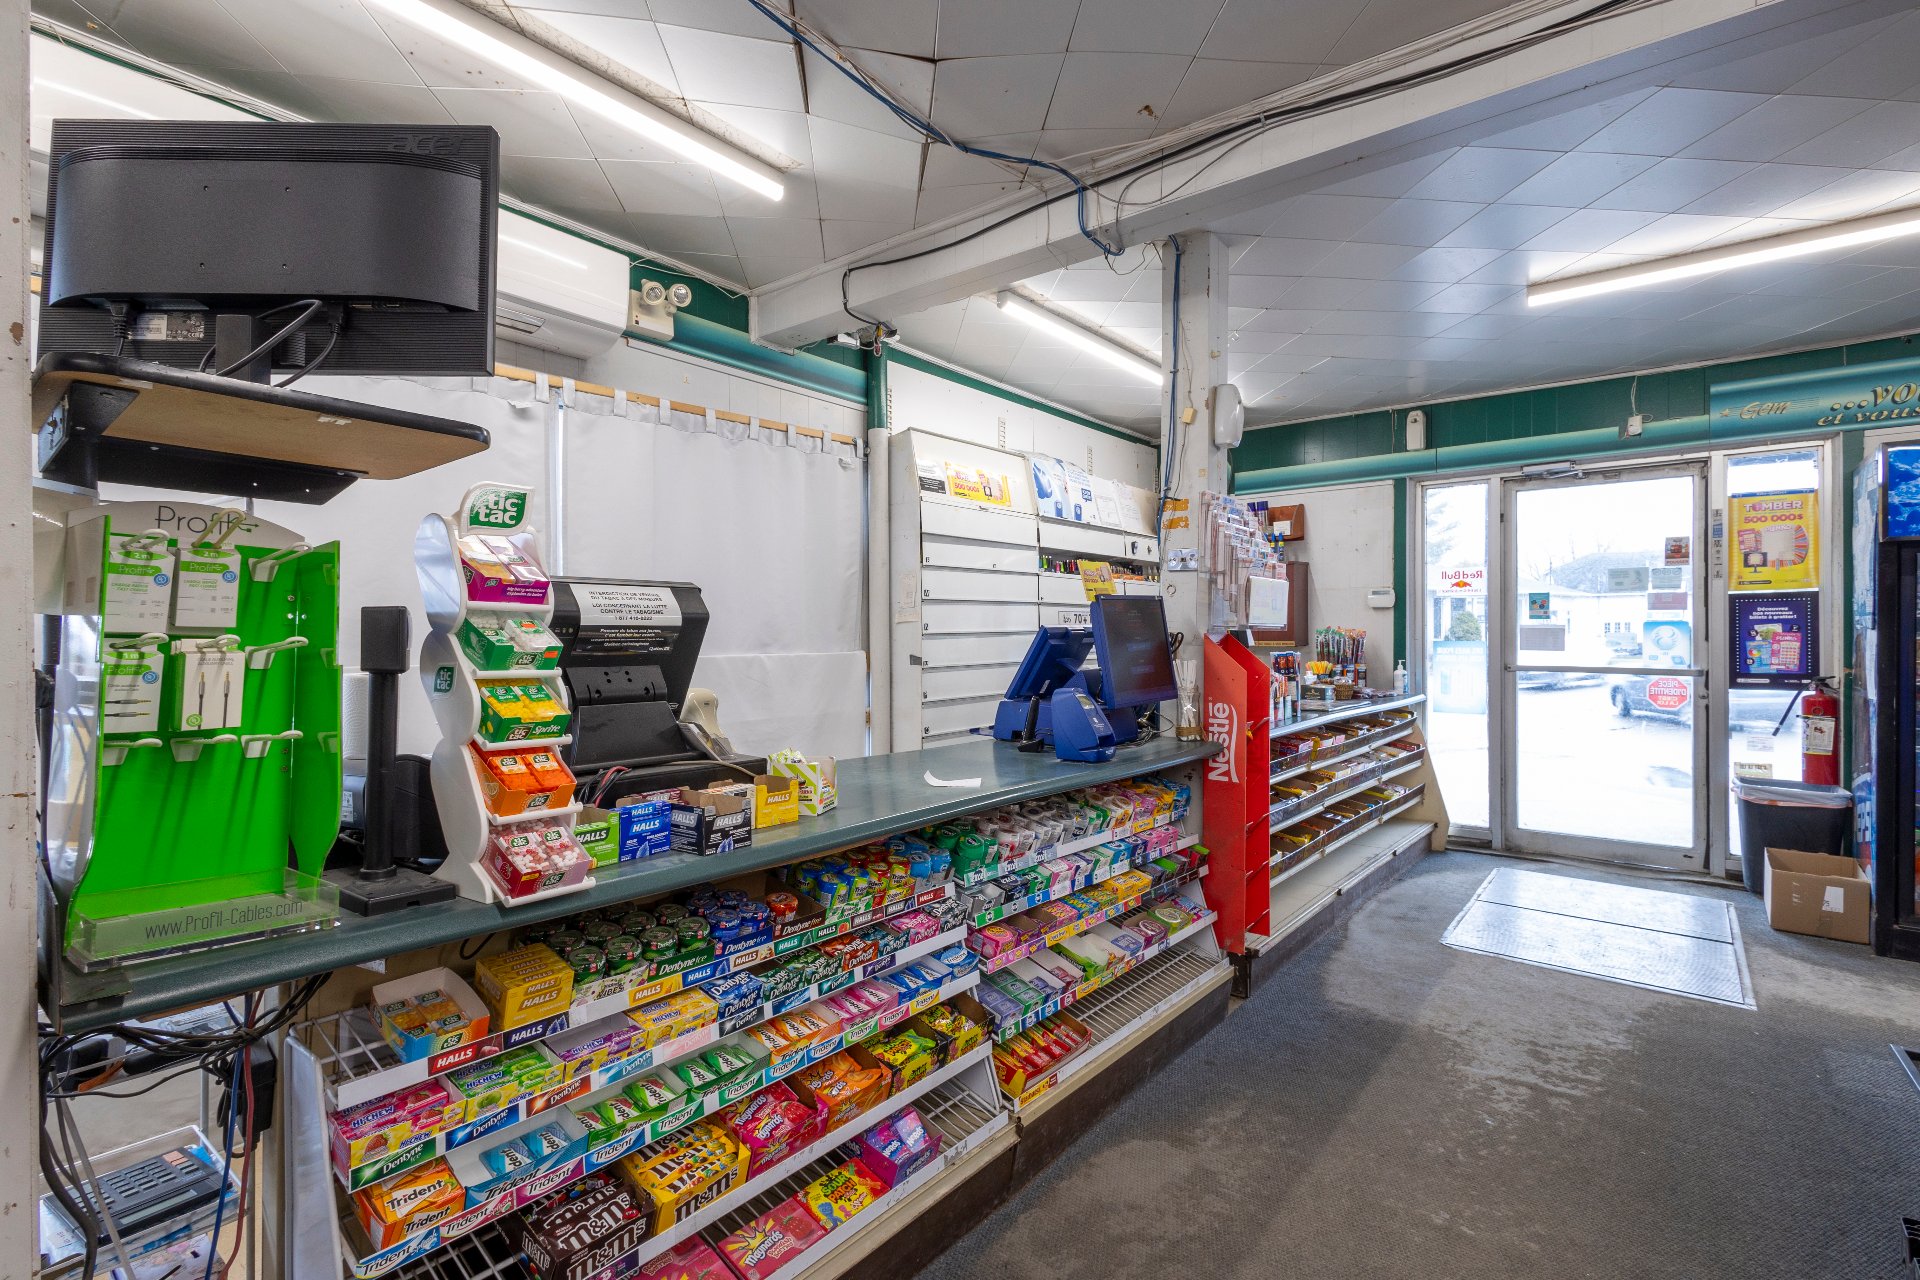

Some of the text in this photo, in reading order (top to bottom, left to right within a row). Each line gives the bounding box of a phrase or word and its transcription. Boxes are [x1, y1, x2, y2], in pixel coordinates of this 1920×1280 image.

[1817, 413, 1844, 426] et
[487, 493, 519, 512] tic
[478, 507, 517, 525] tac
[436, 679, 450, 690] tac
[440, 670, 451, 681] tic
[513, 726, 530, 735] tic
[532, 724, 561, 734] Sprite
[767, 793, 790, 803] HALLS
[632, 806, 653, 816] HALLS
[671, 813, 695, 824] HALLS
[632, 820, 660, 833] HALLS
[716, 814, 742, 827] HALLS
[577, 830, 607, 842] HALLS
[919, 892, 934, 902] HALLS
[888, 904, 904, 914] HALLS
[145, 899, 303, 940] www.Profil-Cables.com
[783, 920, 811, 935] Dentyne
[854, 914, 872, 924] HALLS
[818, 925, 836, 937] HALLS
[725, 940, 756, 955] Dentyne
[779, 939, 798, 950] HALLS
[659, 958, 696, 976] Dentyne
[735, 952, 757, 965] HALLS
[525, 970, 553, 982] HALLS
[688, 968, 711, 982] HALLS
[811, 957, 841, 984] Dentyne
[527, 979, 556, 993] HALLS
[635, 985, 661, 1000] HALLS
[711, 971, 749, 996] Dentyne
[770, 975, 800, 999] Dentyne
[522, 990, 558, 1008] HALLS
[724, 990, 758, 1017] Dentyne
[883, 1009, 906, 1024] Trident
[511, 1025, 543, 1043] HALLS
[850, 1022, 873, 1039] Trident
[812, 1040, 837, 1056] Trident
[436, 1049, 474, 1069] HALLS
[622, 1050, 652, 1076] Dentyne
[771, 1057, 799, 1077] Trident
[550, 1079, 581, 1104] Dentyne
[726, 1077, 757, 1097] Trident
[473, 1108, 509, 1136] Dentyne
[619, 1117, 653, 1137] Trident
[660, 1108, 694, 1130] Trident
[383, 1143, 424, 1174] Dentyne
[595, 1137, 633, 1162] Trident
[484, 1168, 541, 1201] Trident
[528, 1167, 572, 1195] Trident
[821, 1173, 849, 1195] SOUR
[386, 1179, 445, 1211] Trident
[674, 1165, 739, 1225] m&m's
[827, 1178, 858, 1204] PATCH
[405, 1205, 451, 1232] Trident
[444, 1206, 489, 1235] Trident
[558, 1192, 631, 1250] m&m's
[744, 1230, 784, 1267] maynards
[363, 1245, 412, 1276] Trident
